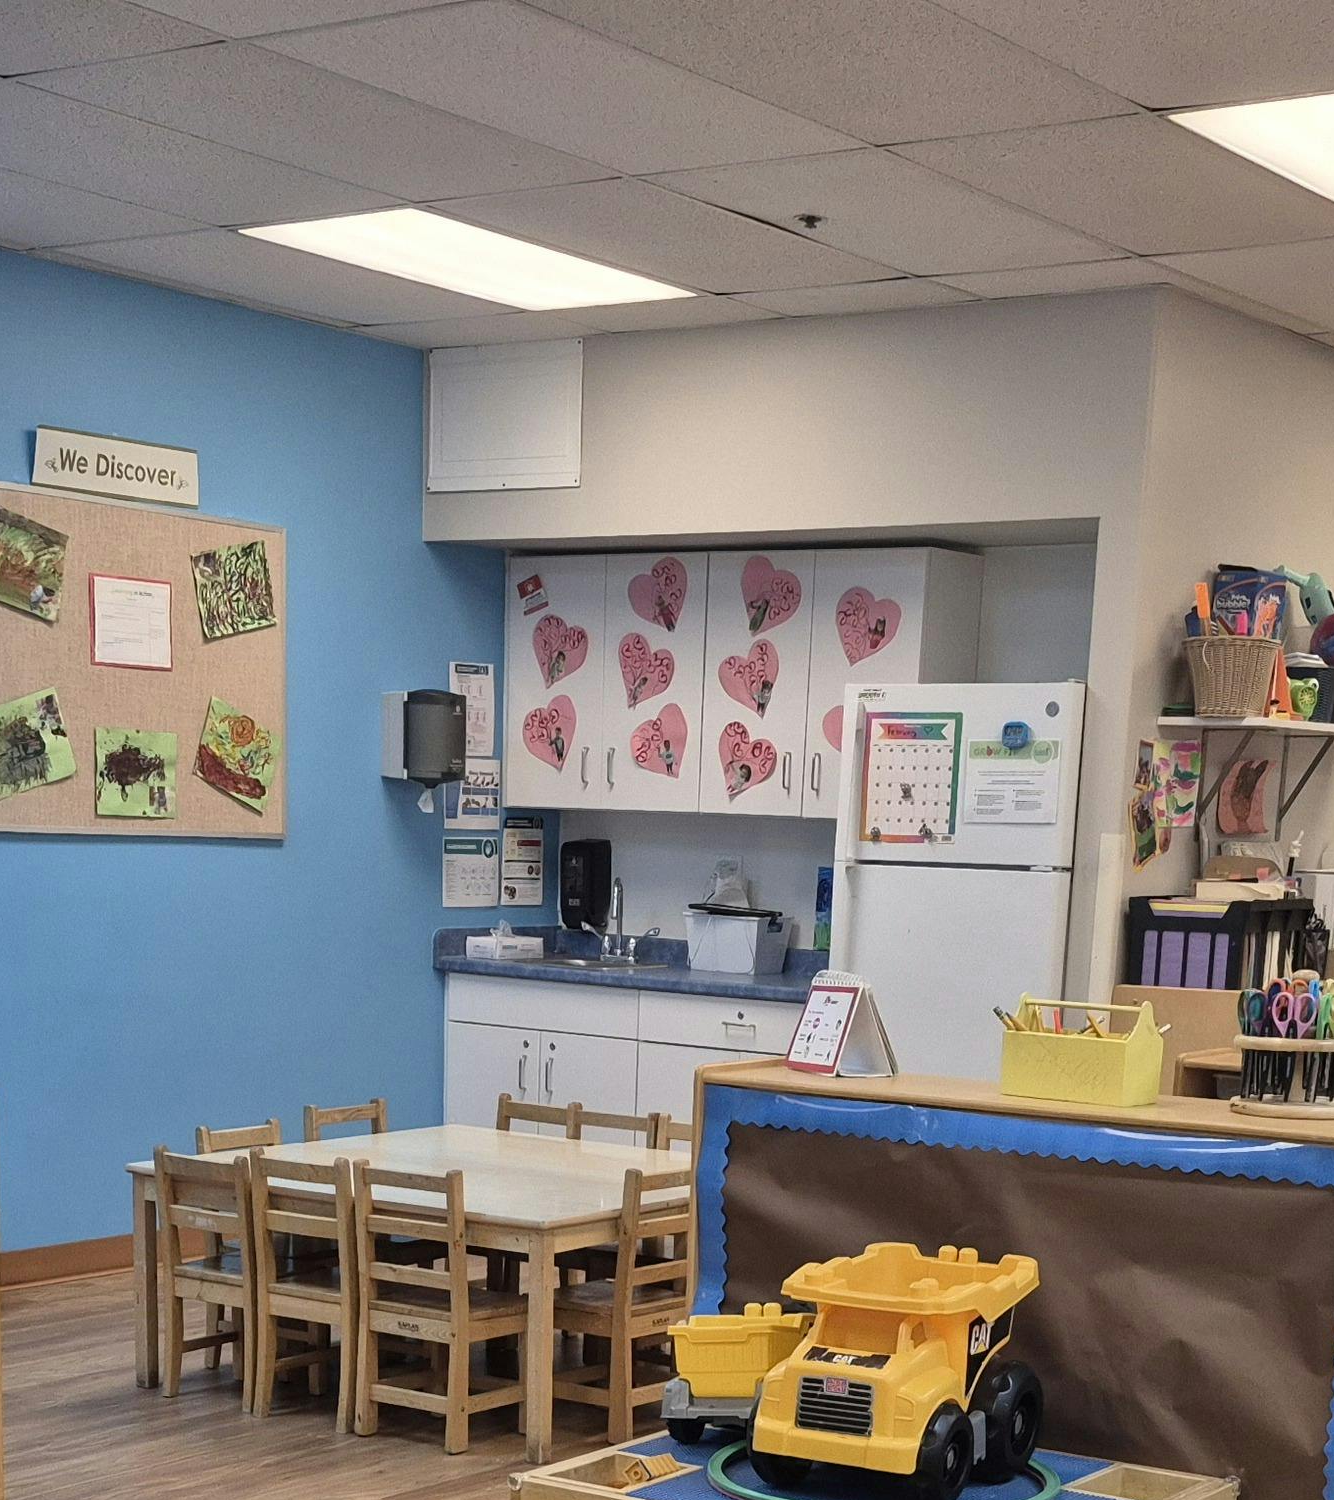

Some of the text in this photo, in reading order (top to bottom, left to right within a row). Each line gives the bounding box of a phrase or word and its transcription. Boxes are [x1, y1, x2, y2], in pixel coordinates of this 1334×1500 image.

[59, 447, 176, 487] We Discover
[969, 1322, 995, 1356] CAT
[832, 1354, 858, 1365] CAT
